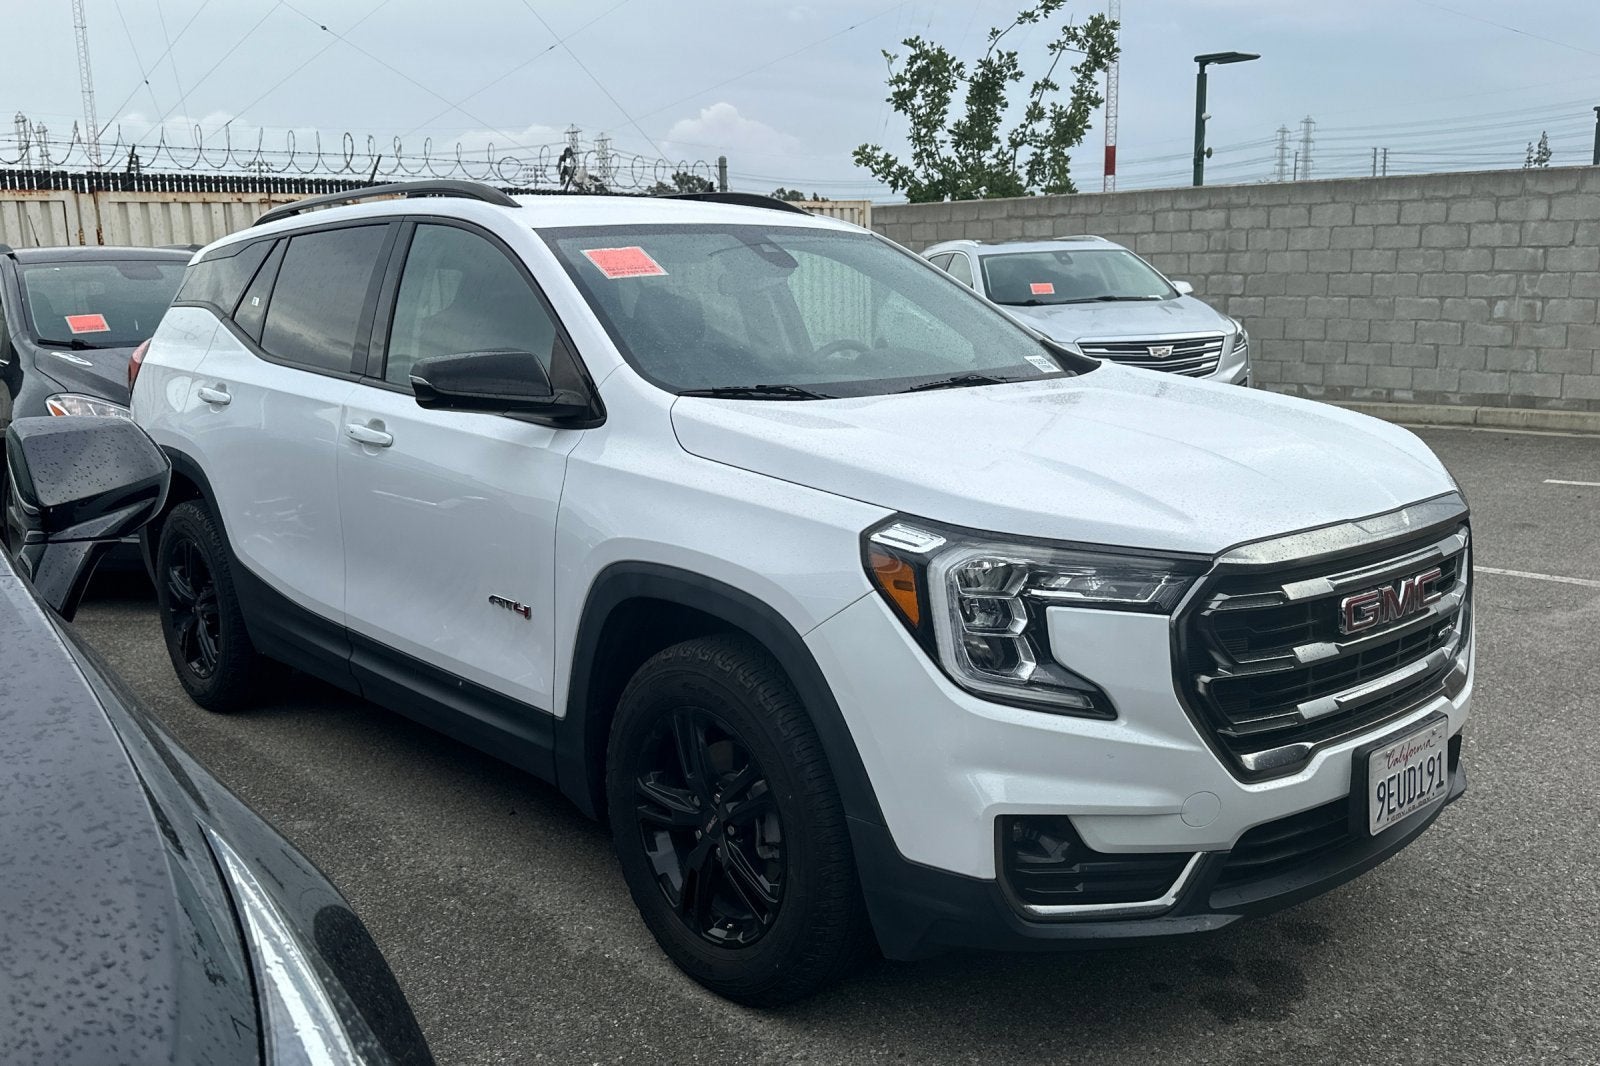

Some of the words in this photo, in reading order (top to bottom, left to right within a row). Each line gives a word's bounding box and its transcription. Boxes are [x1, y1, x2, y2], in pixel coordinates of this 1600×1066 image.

[489, 594, 532, 620] AT4
[1339, 567, 1442, 635] GMC
[1387, 737, 1436, 769] California
[1376, 750, 1445, 822] 9EUD191
